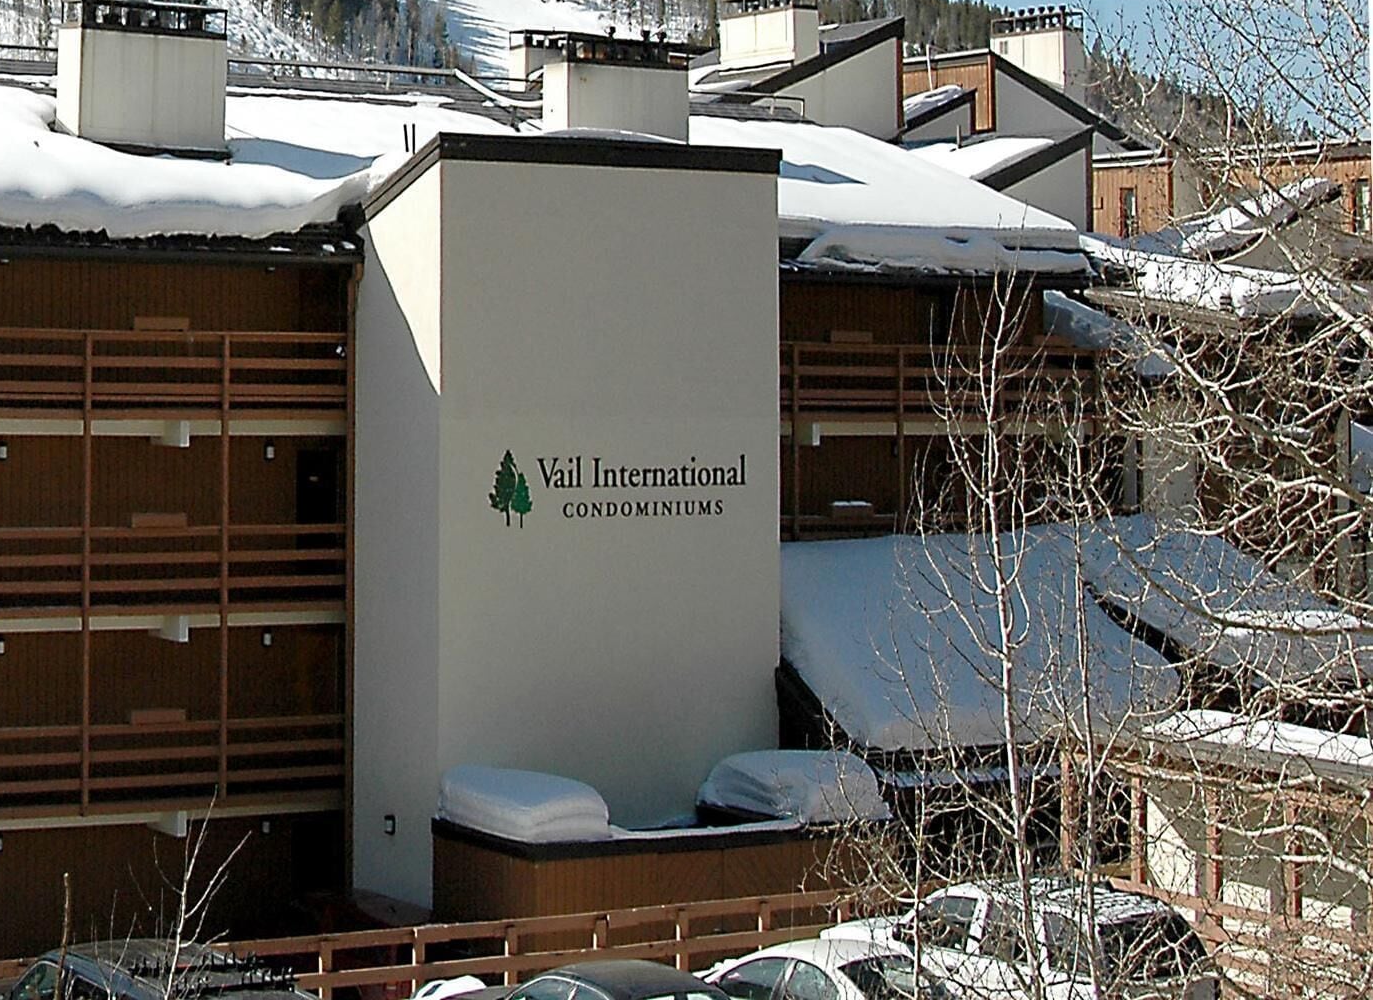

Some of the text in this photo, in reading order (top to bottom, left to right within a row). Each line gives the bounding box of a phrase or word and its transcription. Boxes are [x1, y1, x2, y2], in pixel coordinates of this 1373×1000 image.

[537, 453, 747, 488] Vail International
[562, 499, 724, 519] CONDOMINIUMS
